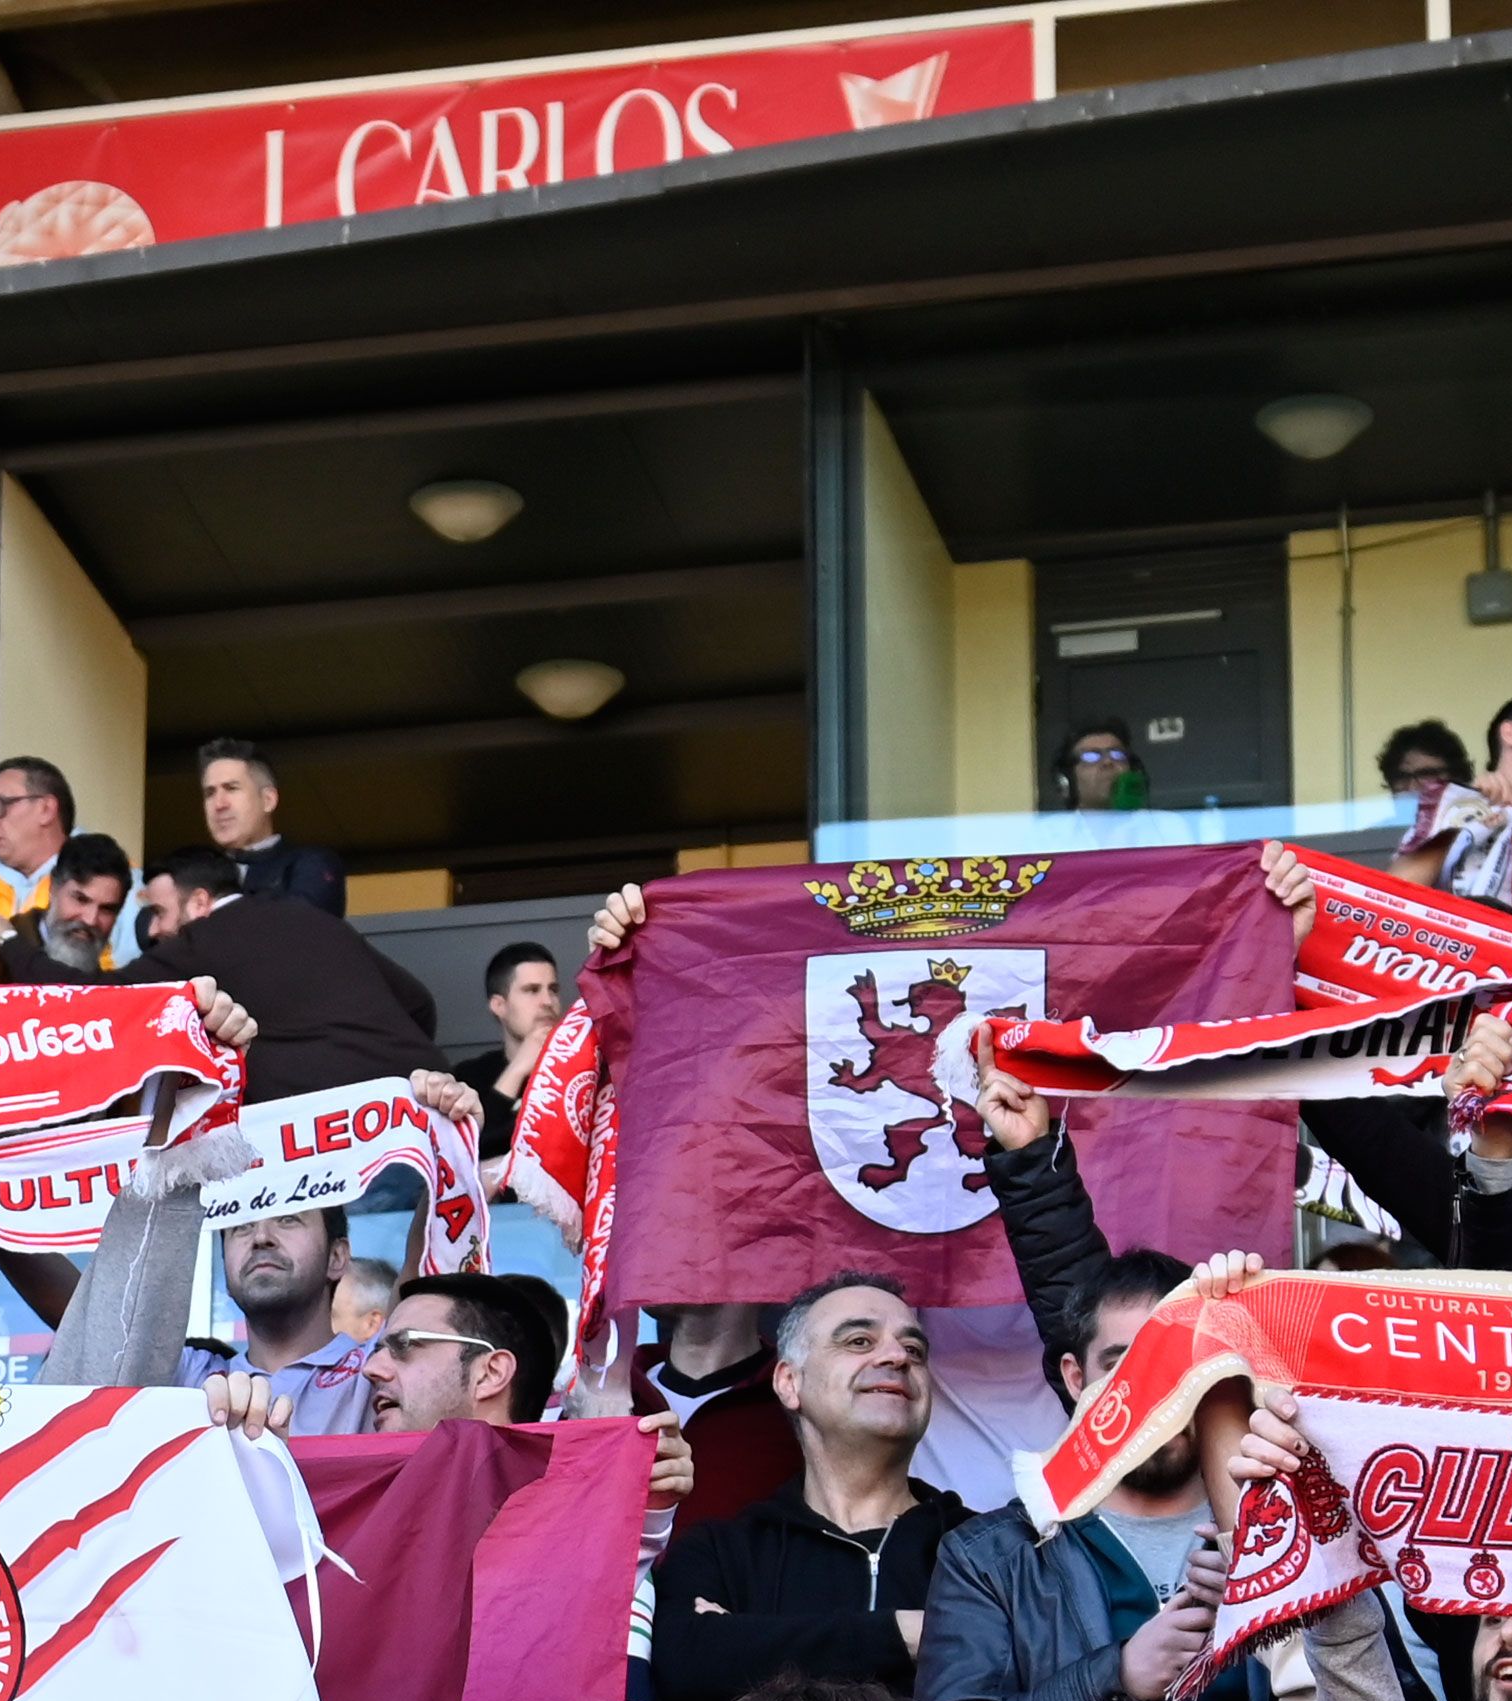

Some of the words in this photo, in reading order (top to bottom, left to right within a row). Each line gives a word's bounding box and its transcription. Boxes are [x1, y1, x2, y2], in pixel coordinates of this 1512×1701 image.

[1324, 896, 1376, 932] León
[1380, 916, 1410, 938] de
[1415, 923, 1478, 962] Reino
[251, 1191, 277, 1211] de
[284, 1170, 347, 1204] León
[1383, 1273, 1424, 1286] ALMA
[1427, 1277, 1505, 1294] CULTURAL
[1364, 1291, 1496, 1318] CULTURAL
[1102, 1423, 1161, 1481] CULTURAL
[1158, 1374, 1203, 1425] ESENCIA
